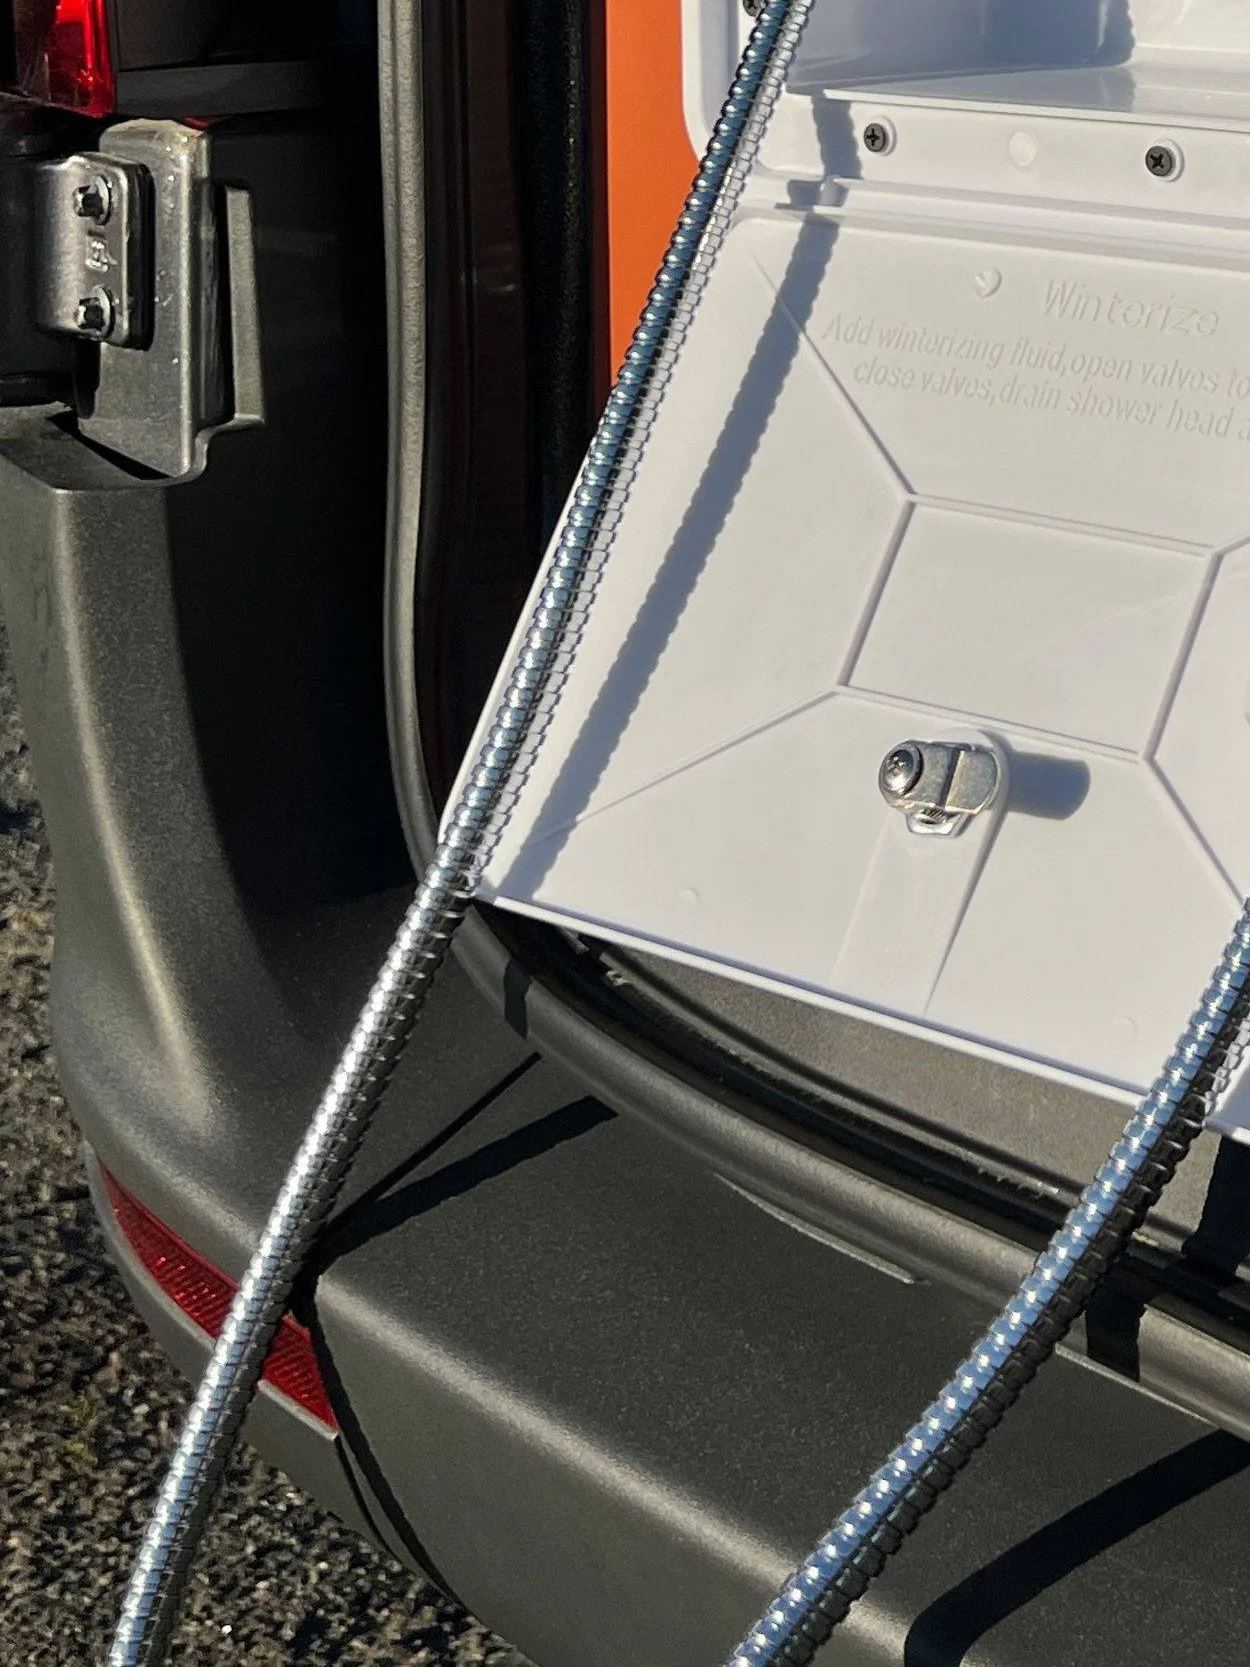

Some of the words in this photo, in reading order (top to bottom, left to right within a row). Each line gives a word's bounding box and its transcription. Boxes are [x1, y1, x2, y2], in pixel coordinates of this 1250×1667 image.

[1042, 279, 1219, 336] Winterize
[821, 312, 875, 346] Add
[878, 322, 1005, 370] winterizing
[1141, 358, 1219, 394] valves
[854, 355, 915, 390] close
[1066, 384, 1162, 426] shower
[1166, 398, 1235, 439] head
